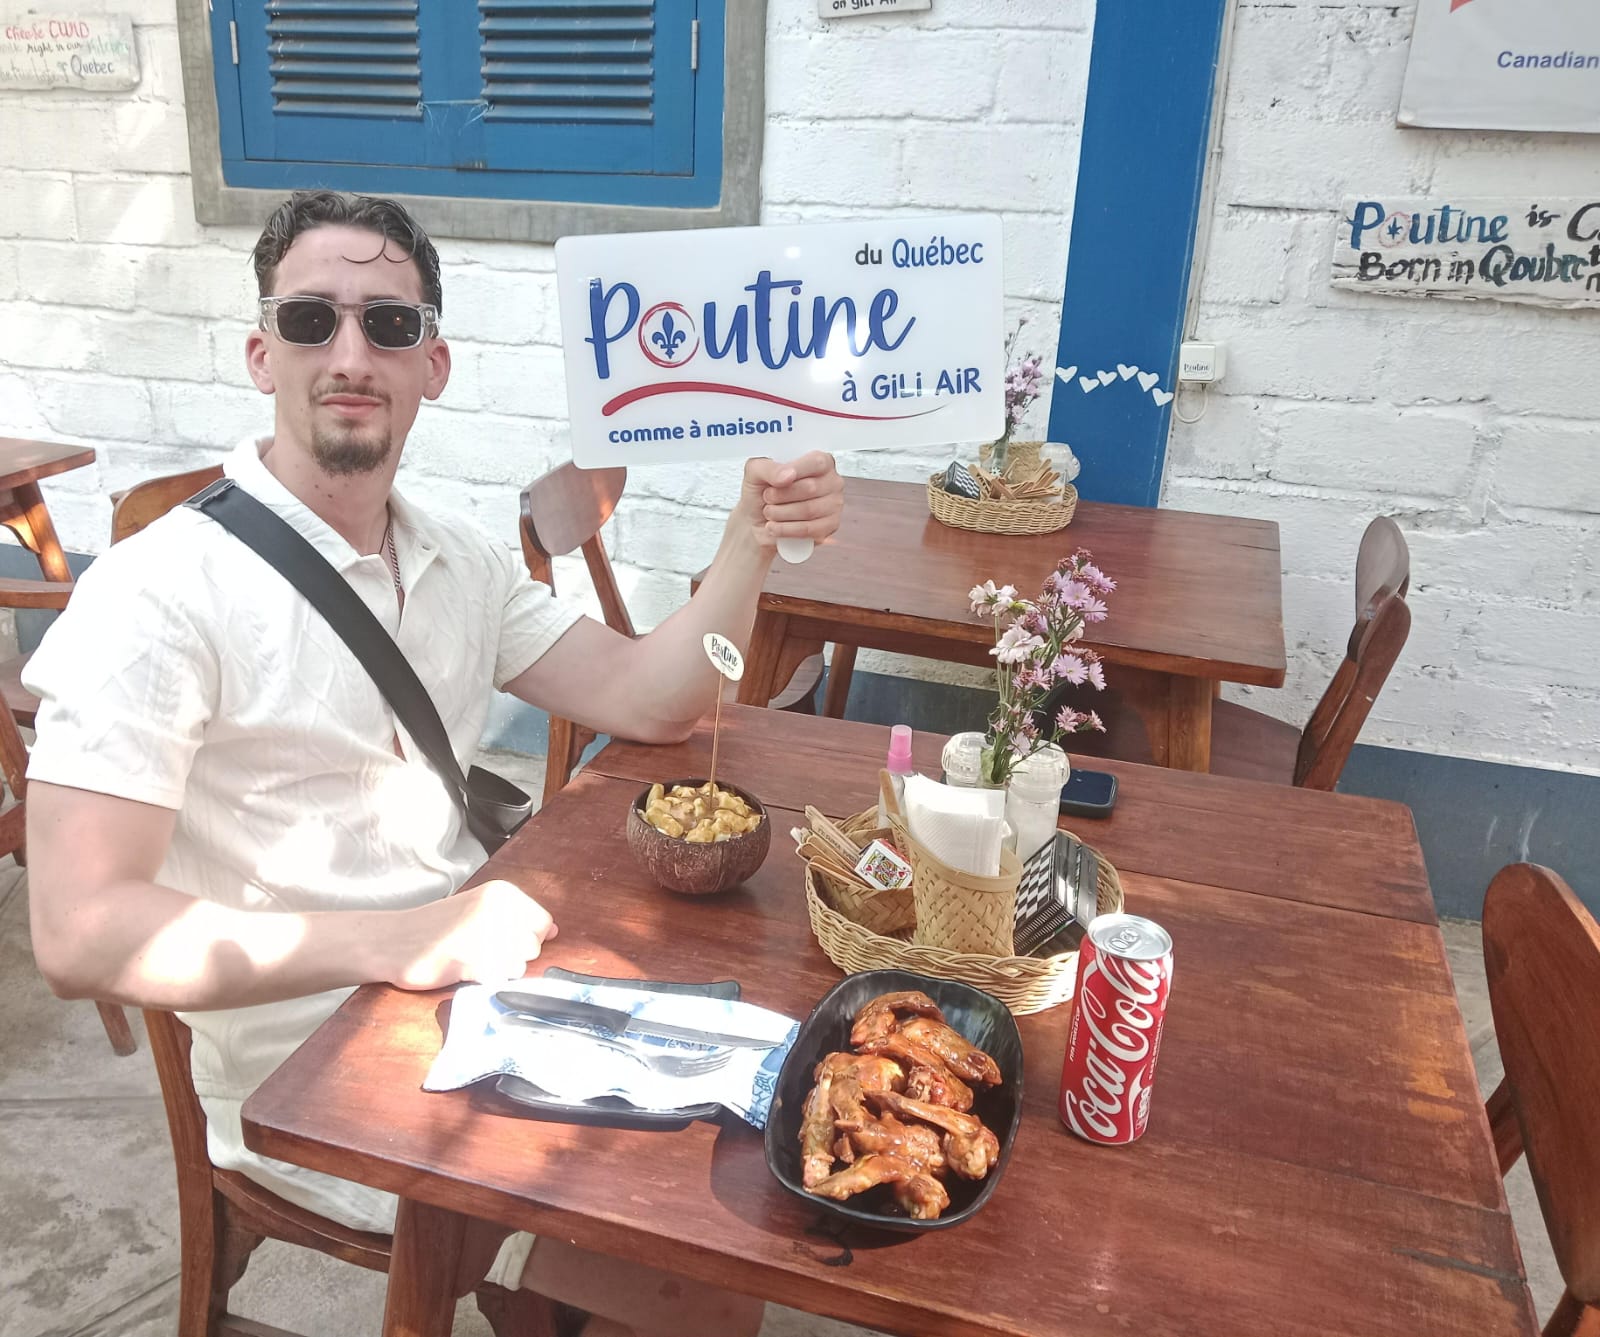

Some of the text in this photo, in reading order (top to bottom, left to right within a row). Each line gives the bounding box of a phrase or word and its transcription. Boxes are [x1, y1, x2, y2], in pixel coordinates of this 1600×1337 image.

[1497, 51, 1600, 69] Canadian
[1525, 204, 1561, 228] is
[855, 236, 984, 268] du Québec
[1356, 251, 1441, 281] Born
[1448, 251, 1475, 284] in
[585, 270, 917, 379] Poutine
[841, 370, 858, 402] à
[608, 426, 684, 443] comme
[690, 420, 701, 438] à
[706, 417, 782, 437] maison
